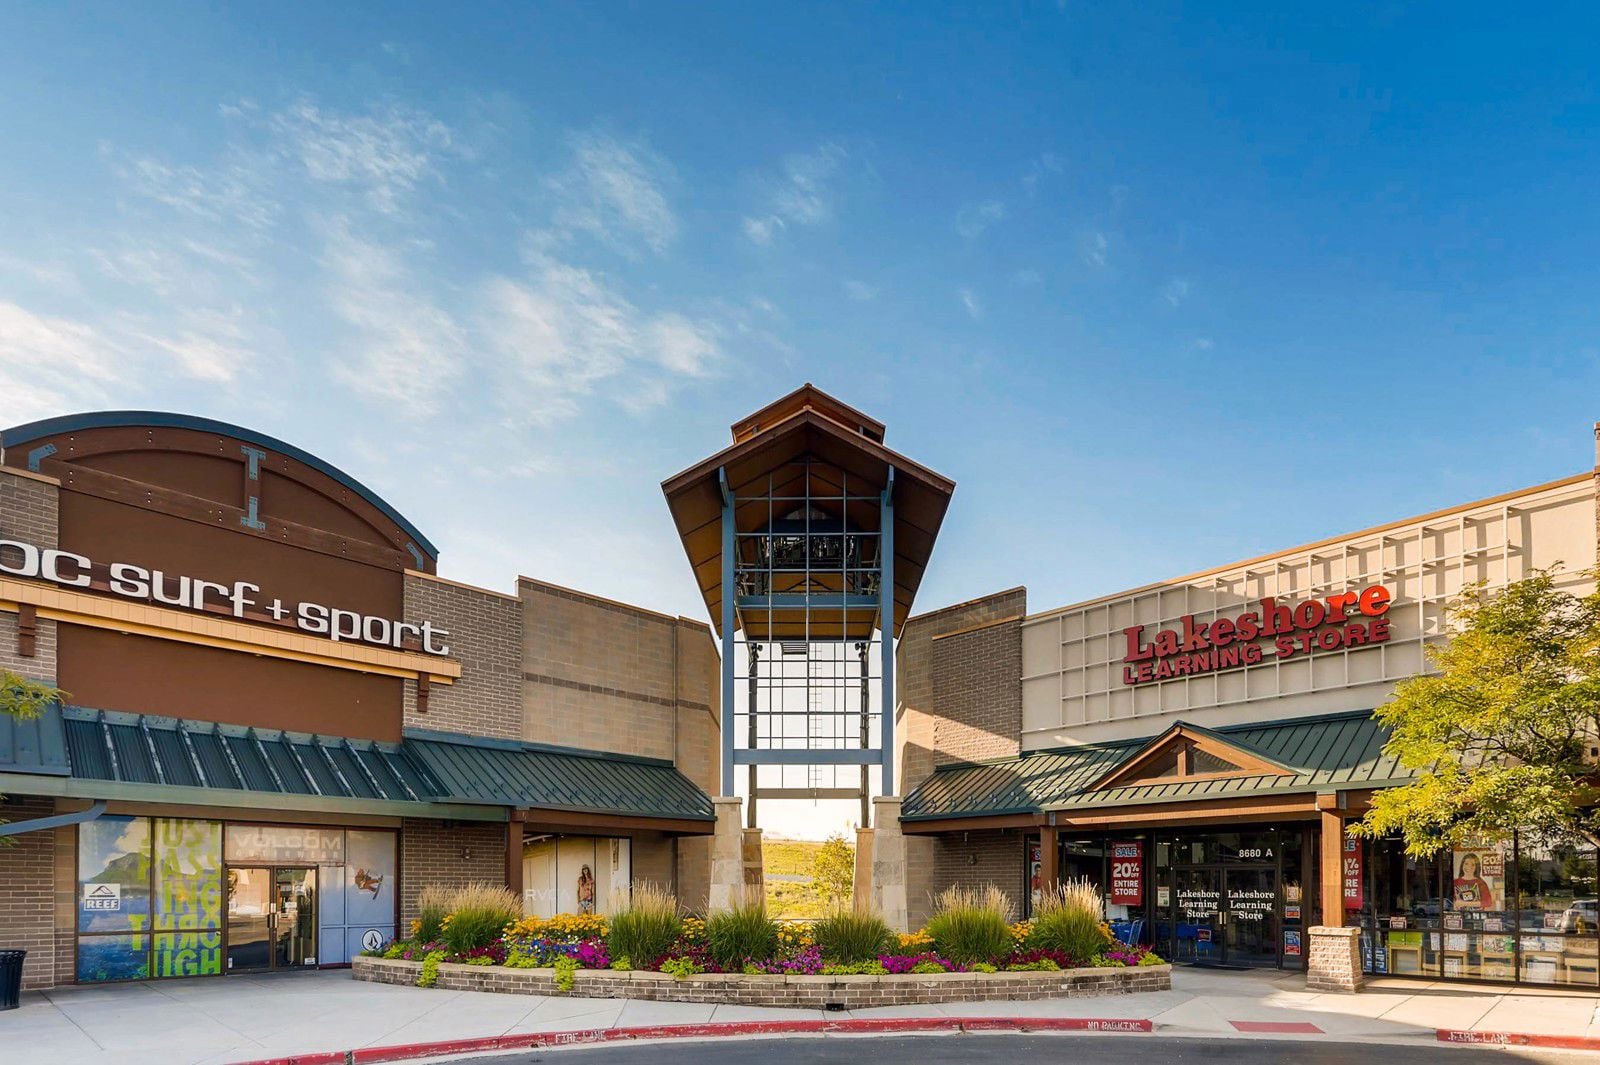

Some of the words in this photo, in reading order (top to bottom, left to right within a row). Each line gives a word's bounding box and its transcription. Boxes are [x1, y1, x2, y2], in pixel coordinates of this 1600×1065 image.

[0, 539, 92, 588] oc
[109, 562, 260, 618] surf
[297, 602, 450, 656] sport
[1123, 584, 1391, 663] Lakeshore
[1123, 641, 1263, 685] LEARNING
[1275, 618, 1391, 659] STORE
[234, 832, 341, 850] VOLCOM
[1115, 847, 1138, 858] SALE
[1238, 849, 1261, 858] 8680
[1265, 848, 1273, 857] A
[1113, 862, 1140, 878] 20%
[1113, 880, 1139, 888] ENTIRE
[1114, 888, 1138, 896] STORE
[1176, 889, 1220, 898] Lakeshore
[1228, 890, 1275, 899] Lakeshore
[86, 899, 119, 910] REEF
[1179, 899, 1218, 910] Learning
[1230, 900, 1272, 911] Learning
[1186, 909, 1210, 918] Store
[1238, 910, 1263, 920] Store
[555, 1032, 579, 1044] FIRE
[1448, 1031, 1479, 1042] FIRE
[1481, 1032, 1512, 1044] LANE
